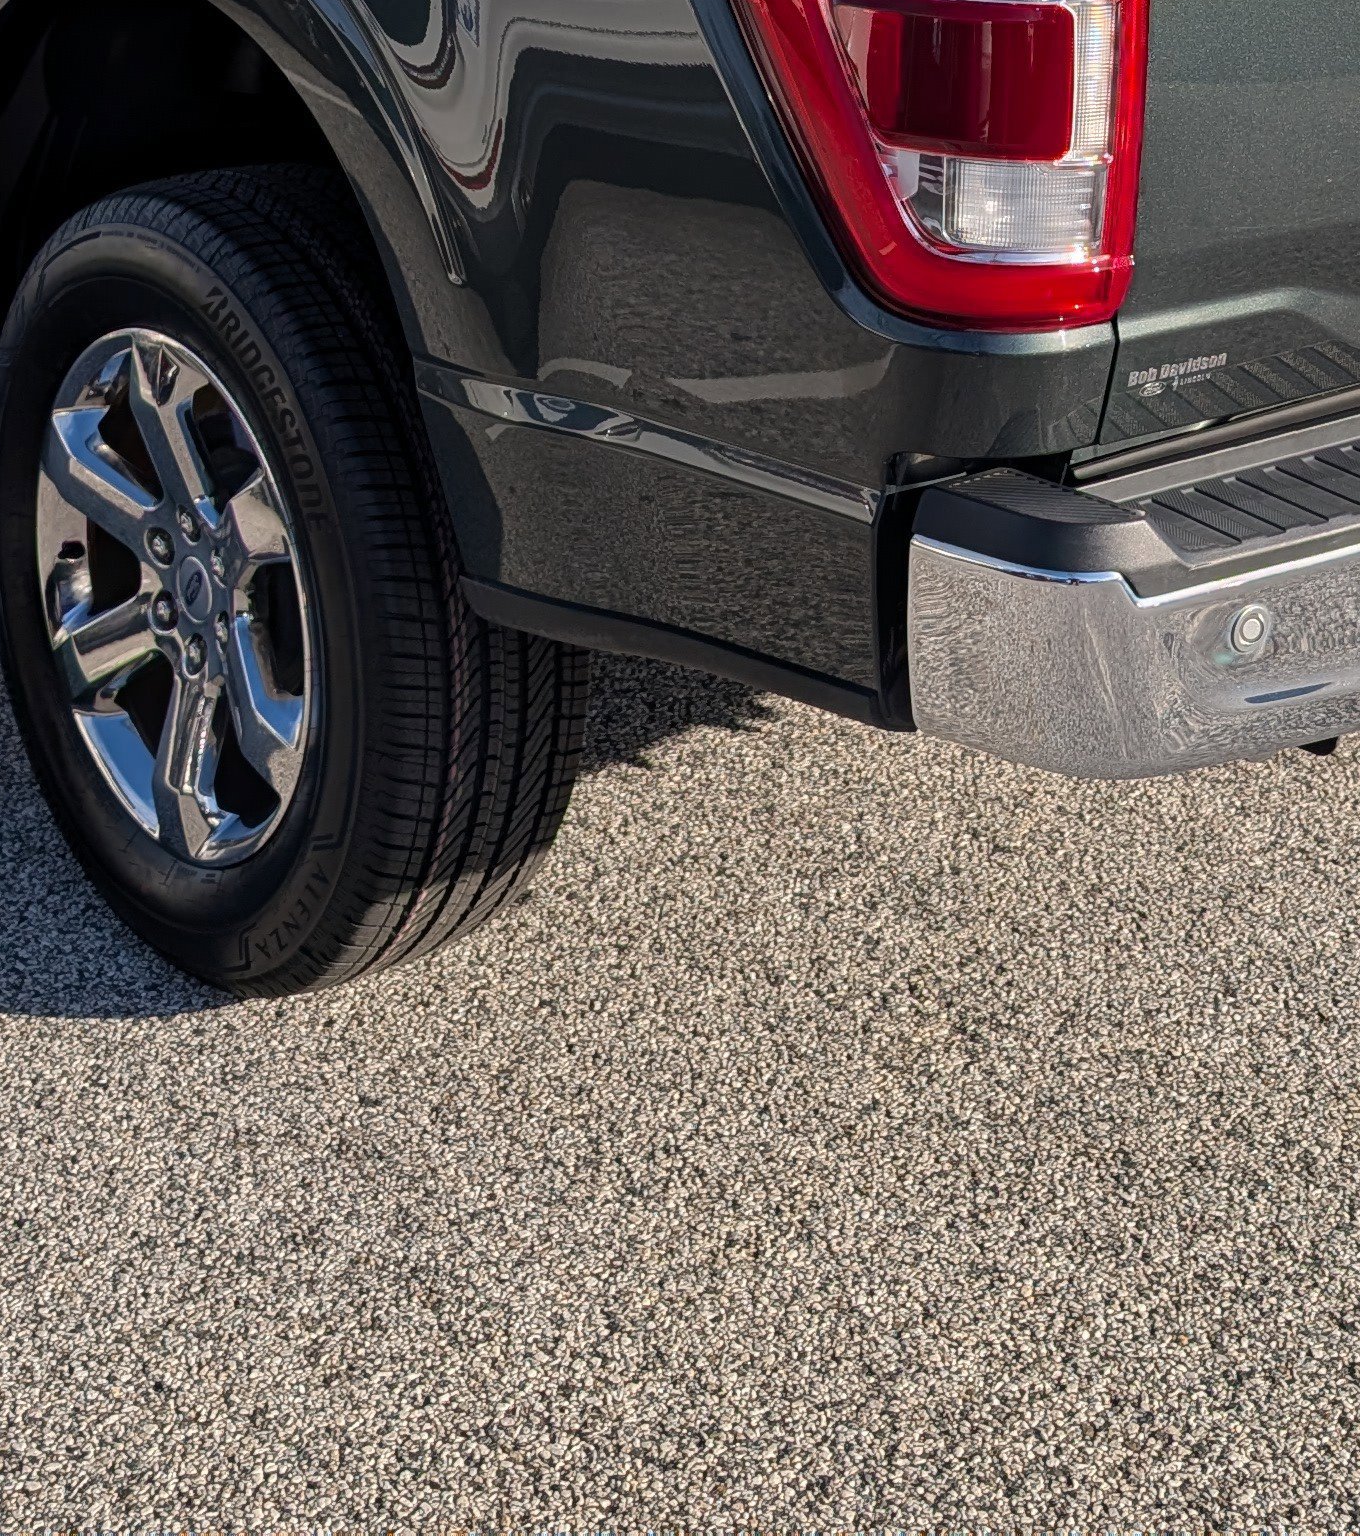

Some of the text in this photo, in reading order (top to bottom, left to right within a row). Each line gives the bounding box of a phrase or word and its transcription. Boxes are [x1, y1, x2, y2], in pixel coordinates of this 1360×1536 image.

[200, 285, 327, 533] BRIDGESTONE
[1127, 352, 1228, 387] Bob Davidson
